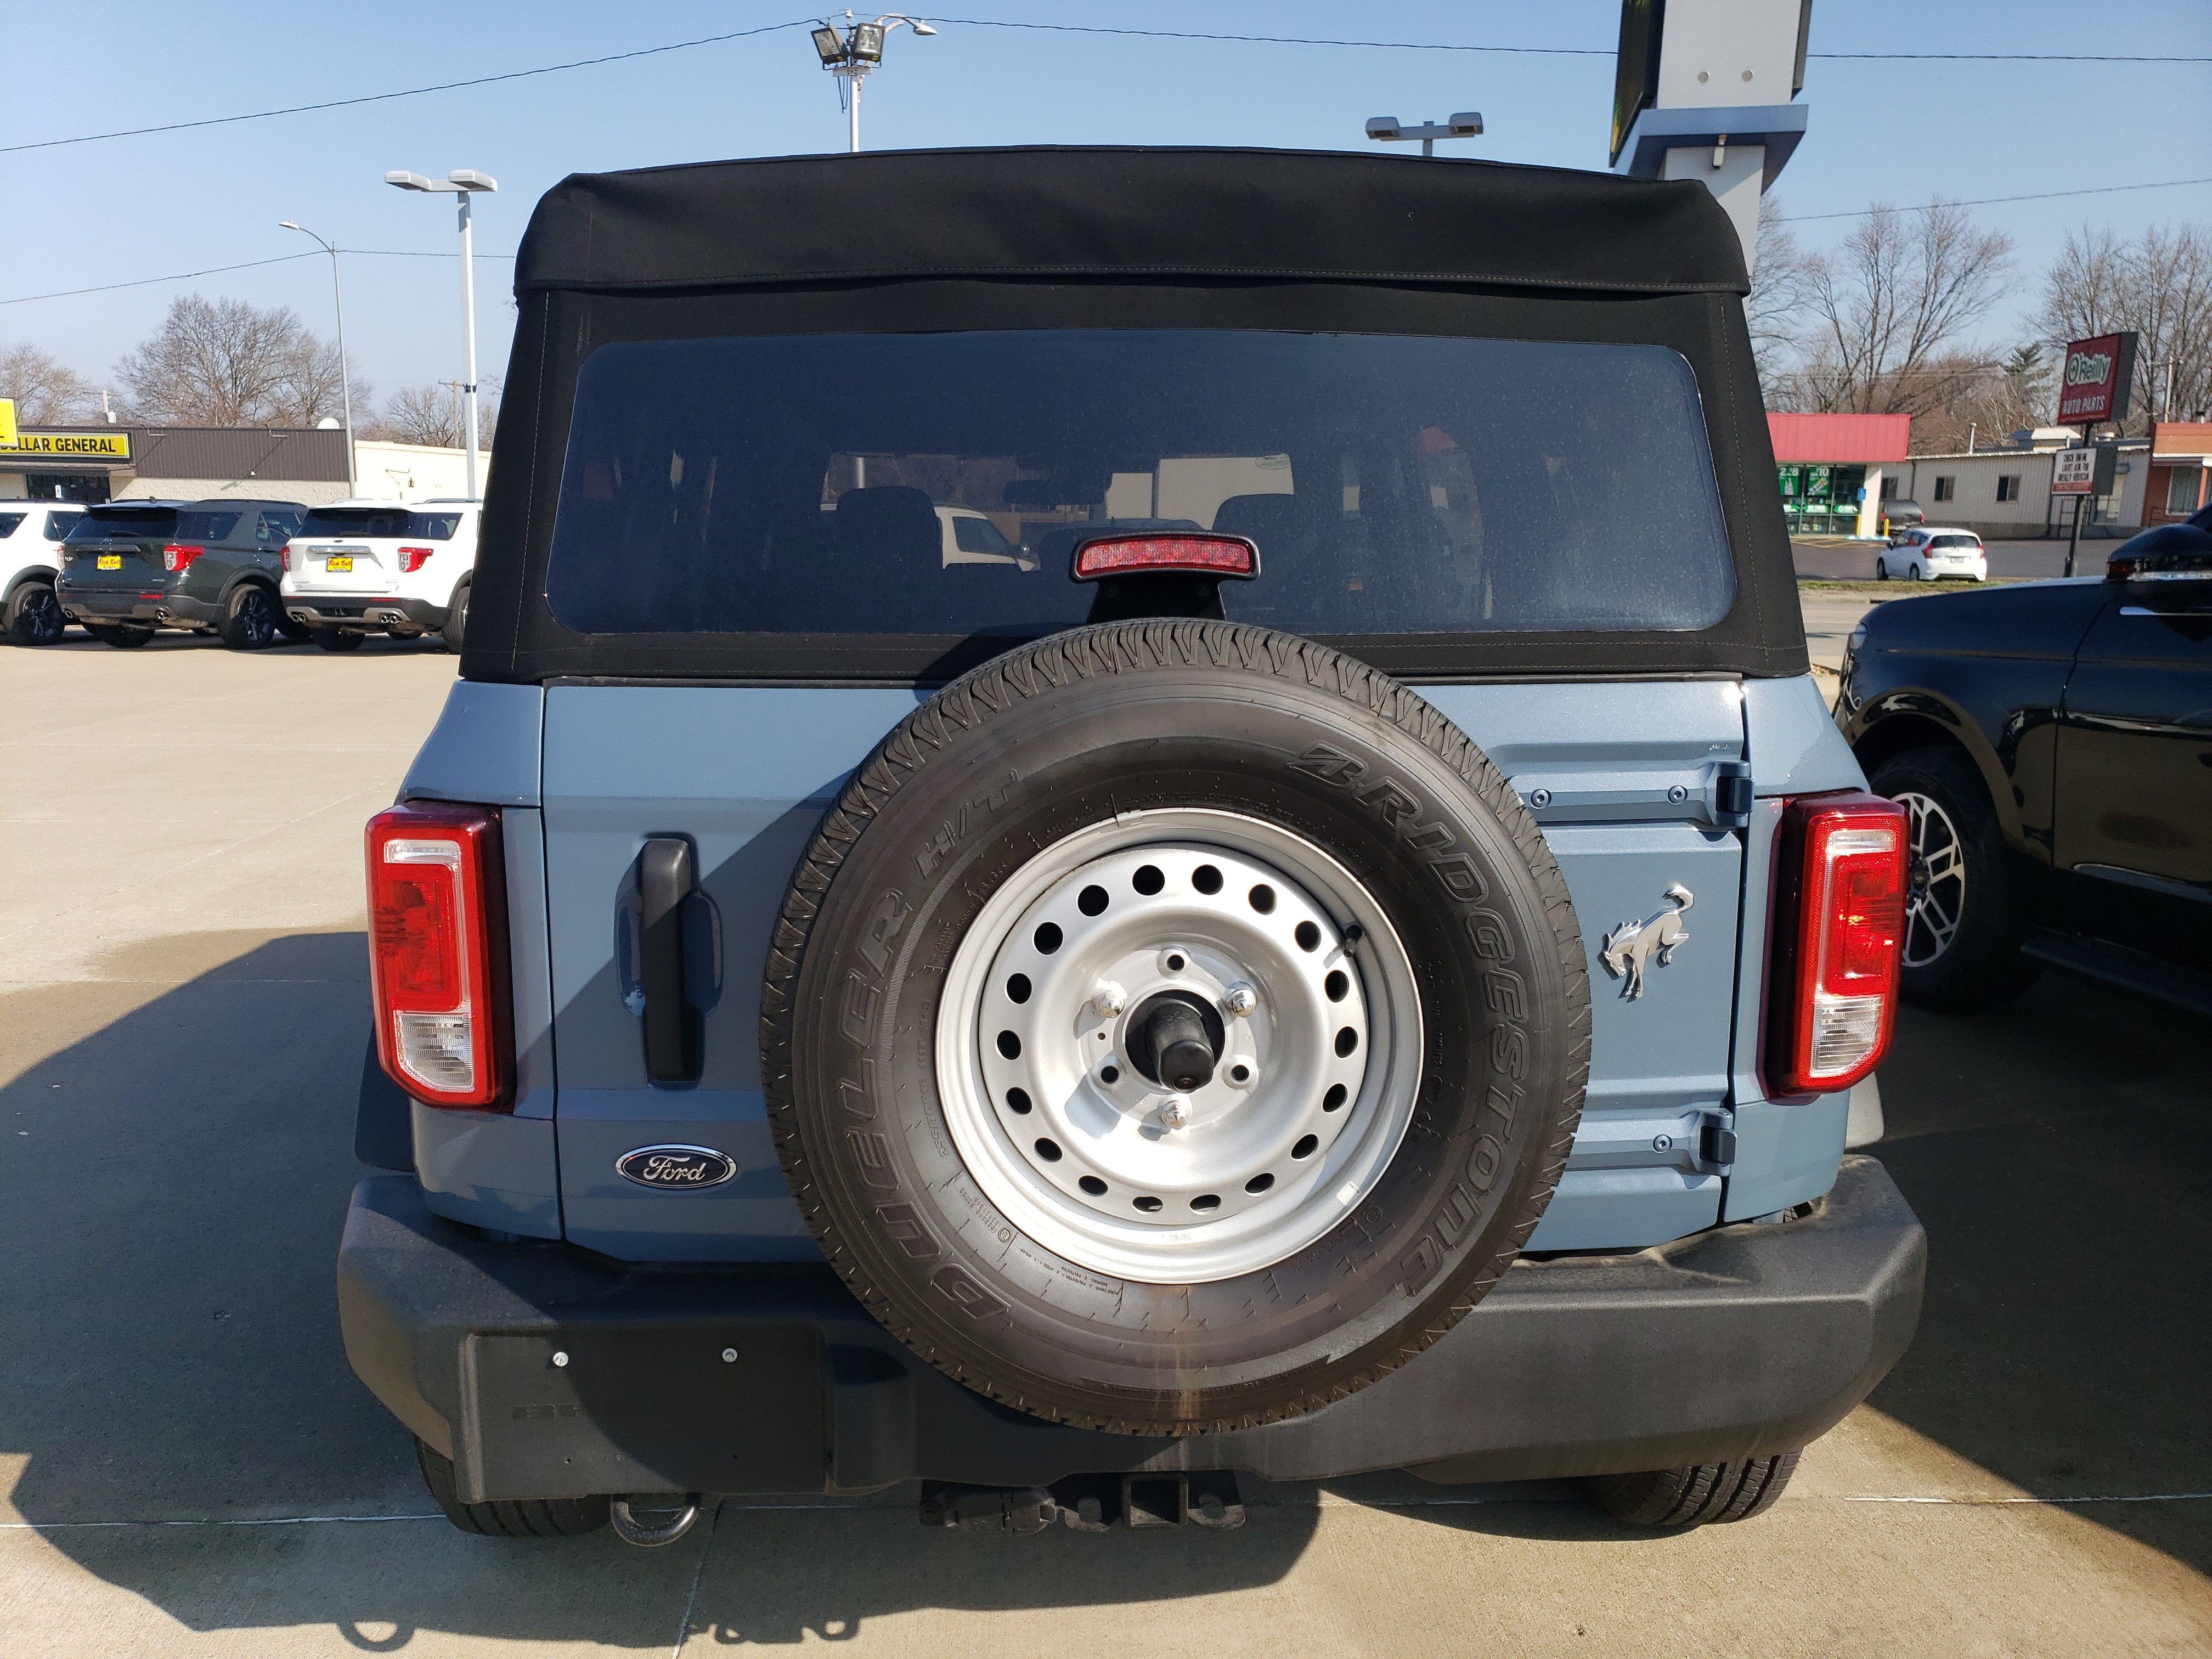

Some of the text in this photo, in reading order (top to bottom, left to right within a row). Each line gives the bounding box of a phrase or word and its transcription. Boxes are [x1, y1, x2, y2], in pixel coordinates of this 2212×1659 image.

[55, 438, 116, 453] GENERAL
[843, 888, 1012, 1319] DUELER
[1286, 746, 1527, 1298] BRIDGESTONE
[642, 1154, 707, 1181] Ford
